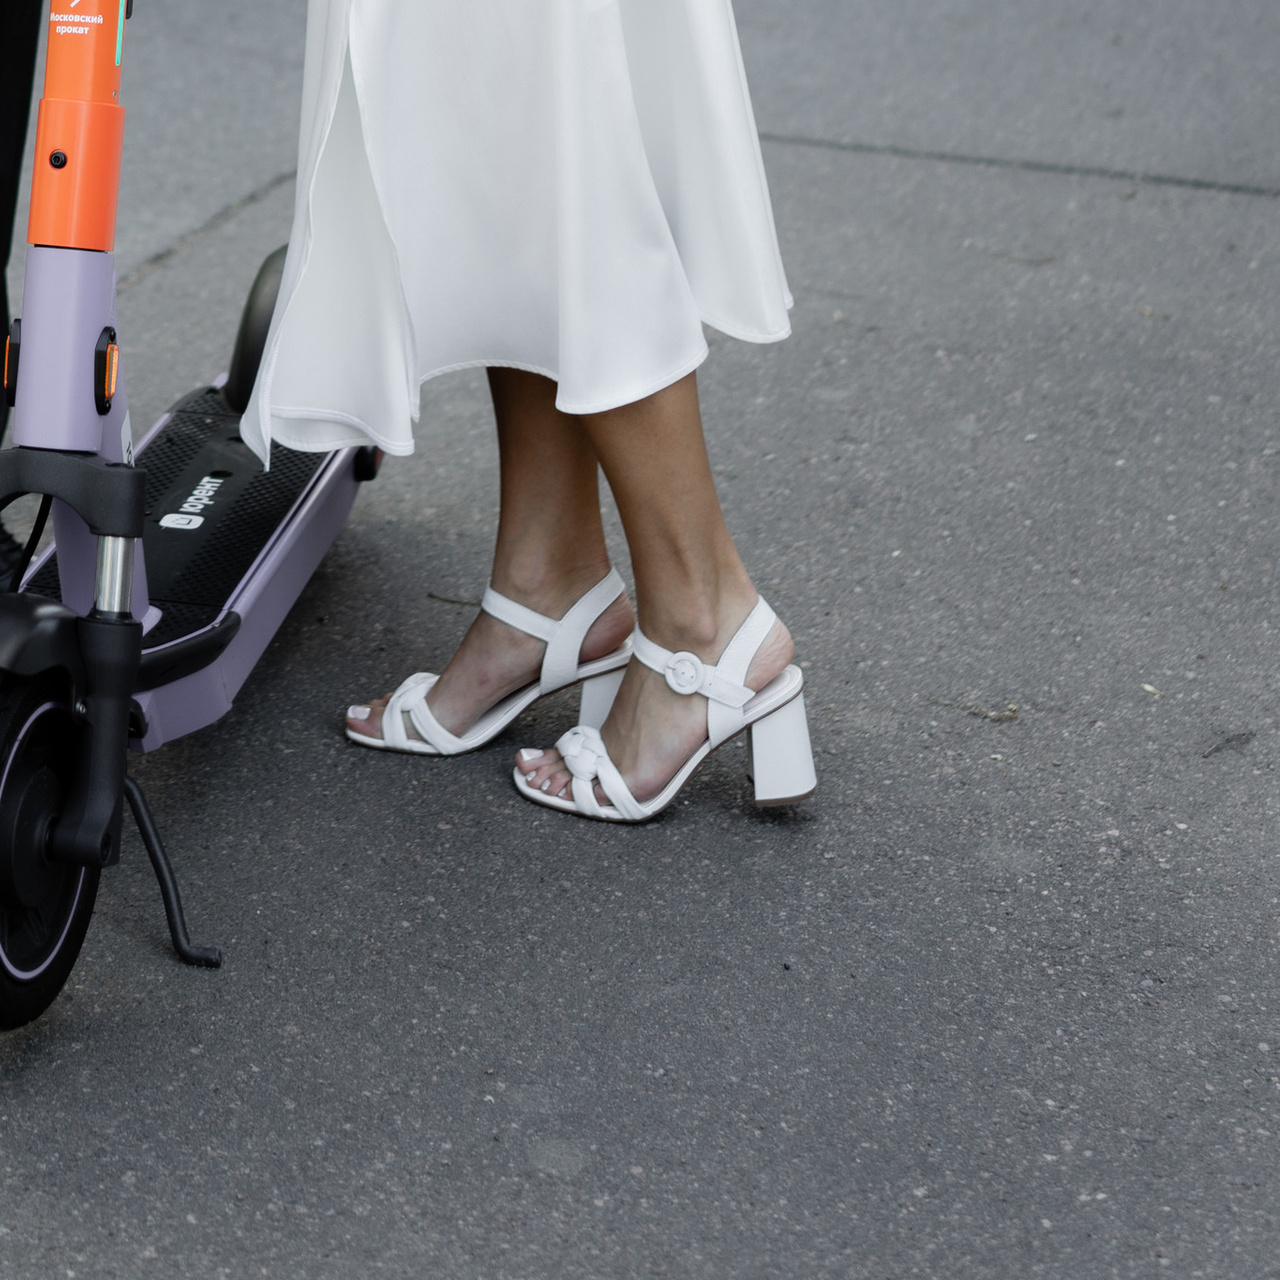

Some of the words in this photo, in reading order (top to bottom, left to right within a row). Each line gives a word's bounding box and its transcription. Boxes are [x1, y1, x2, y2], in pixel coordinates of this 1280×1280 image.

[50, 12, 103, 24] Московский
[56, 26, 89, 35] прокат
[179, 476, 224, 513] юрент
